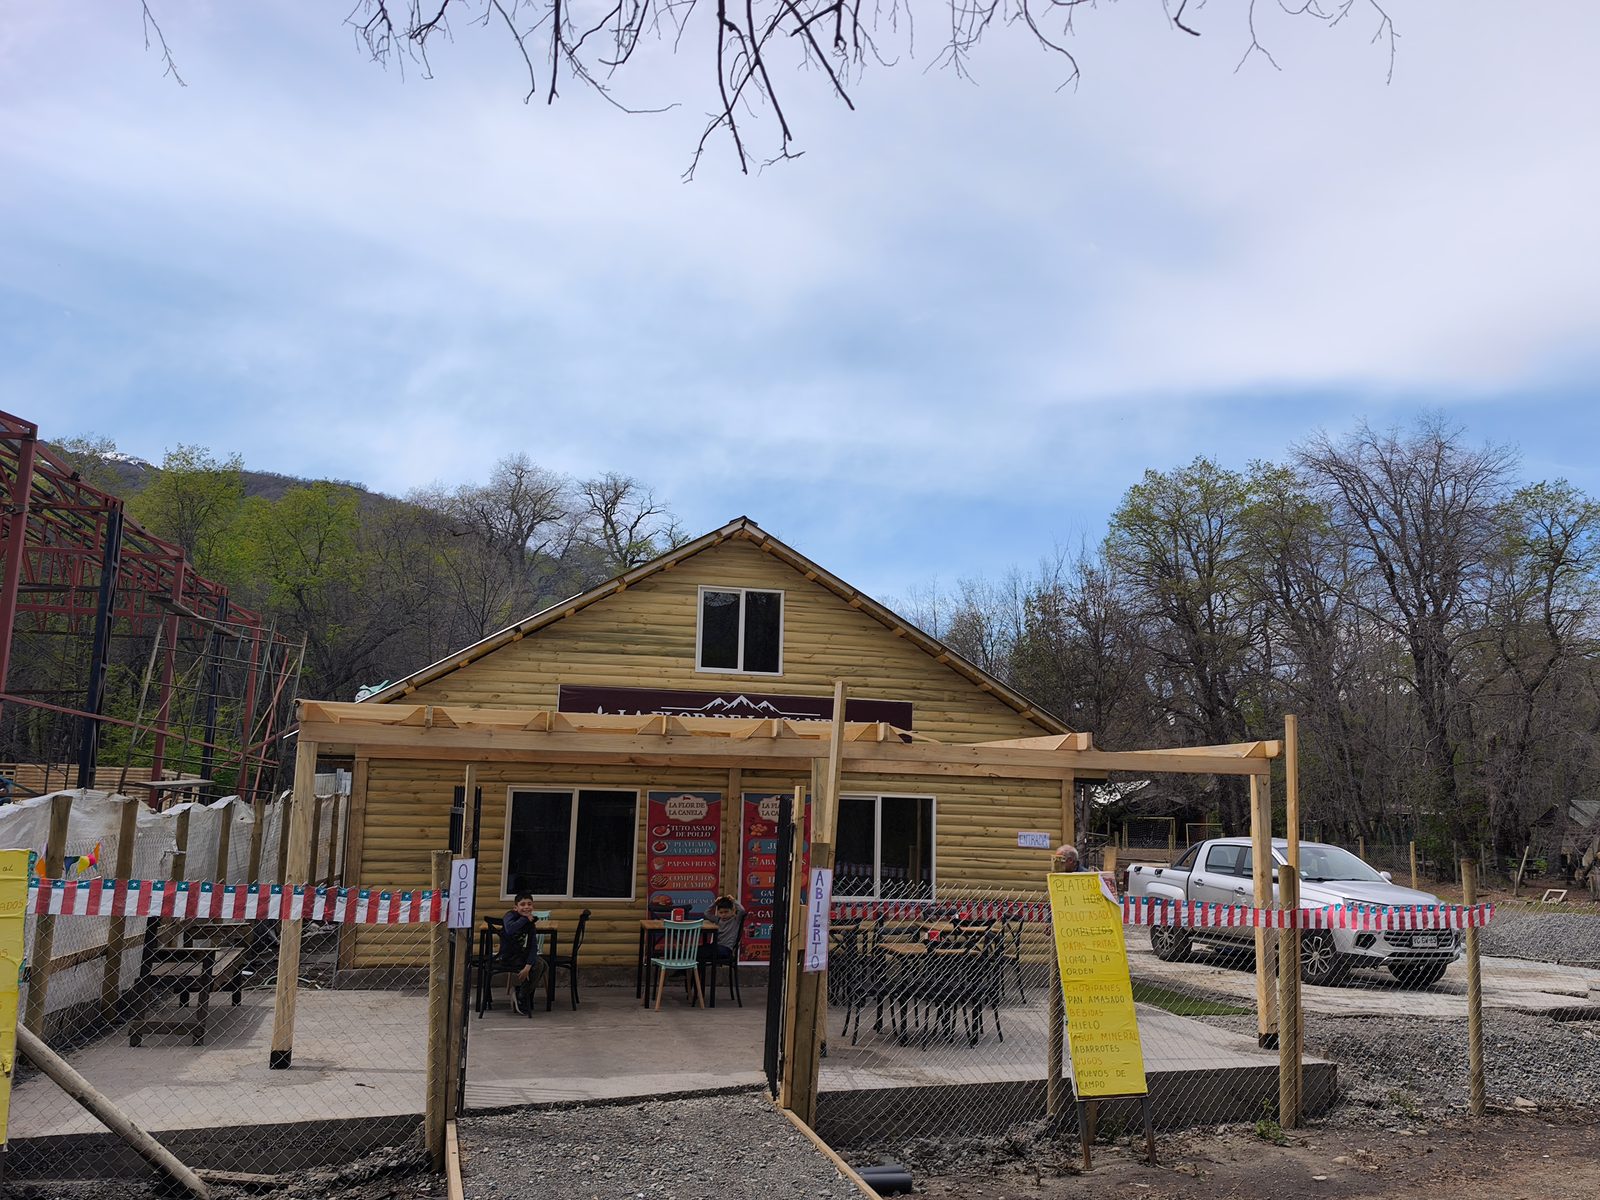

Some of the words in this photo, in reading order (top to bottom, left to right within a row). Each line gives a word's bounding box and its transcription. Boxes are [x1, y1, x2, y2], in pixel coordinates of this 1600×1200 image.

[457, 863, 468, 927] OPEN
[1064, 895, 1075, 907] AL
[811, 870, 824, 969] ABIERTO
[1057, 911, 1085, 922] POLLO
[1089, 910, 1113, 921] ASADO
[1092, 938, 1117, 949] FRITAS
[1065, 954, 1087, 964] LOMO
[1092, 954, 1097, 964] A
[1100, 954, 1111, 963] LA
[1066, 967, 1094, 976] ORDEN
[1066, 983, 1121, 993] CHORIPANES
[1067, 995, 1083, 1004] PAN
[1088, 995, 1125, 1004] AMASADO
[1069, 1008, 1104, 1017] BEBIDAS
[1071, 1020, 1101, 1030] HIELO
[1101, 1031, 1138, 1041] MINERAL
[1075, 1044, 1120, 1054] ABARROTES
[1076, 1056, 1103, 1066] JUGOS
[1116, 1069, 1126, 1078] DE
[1079, 1080, 1105, 1090] CAMPO
